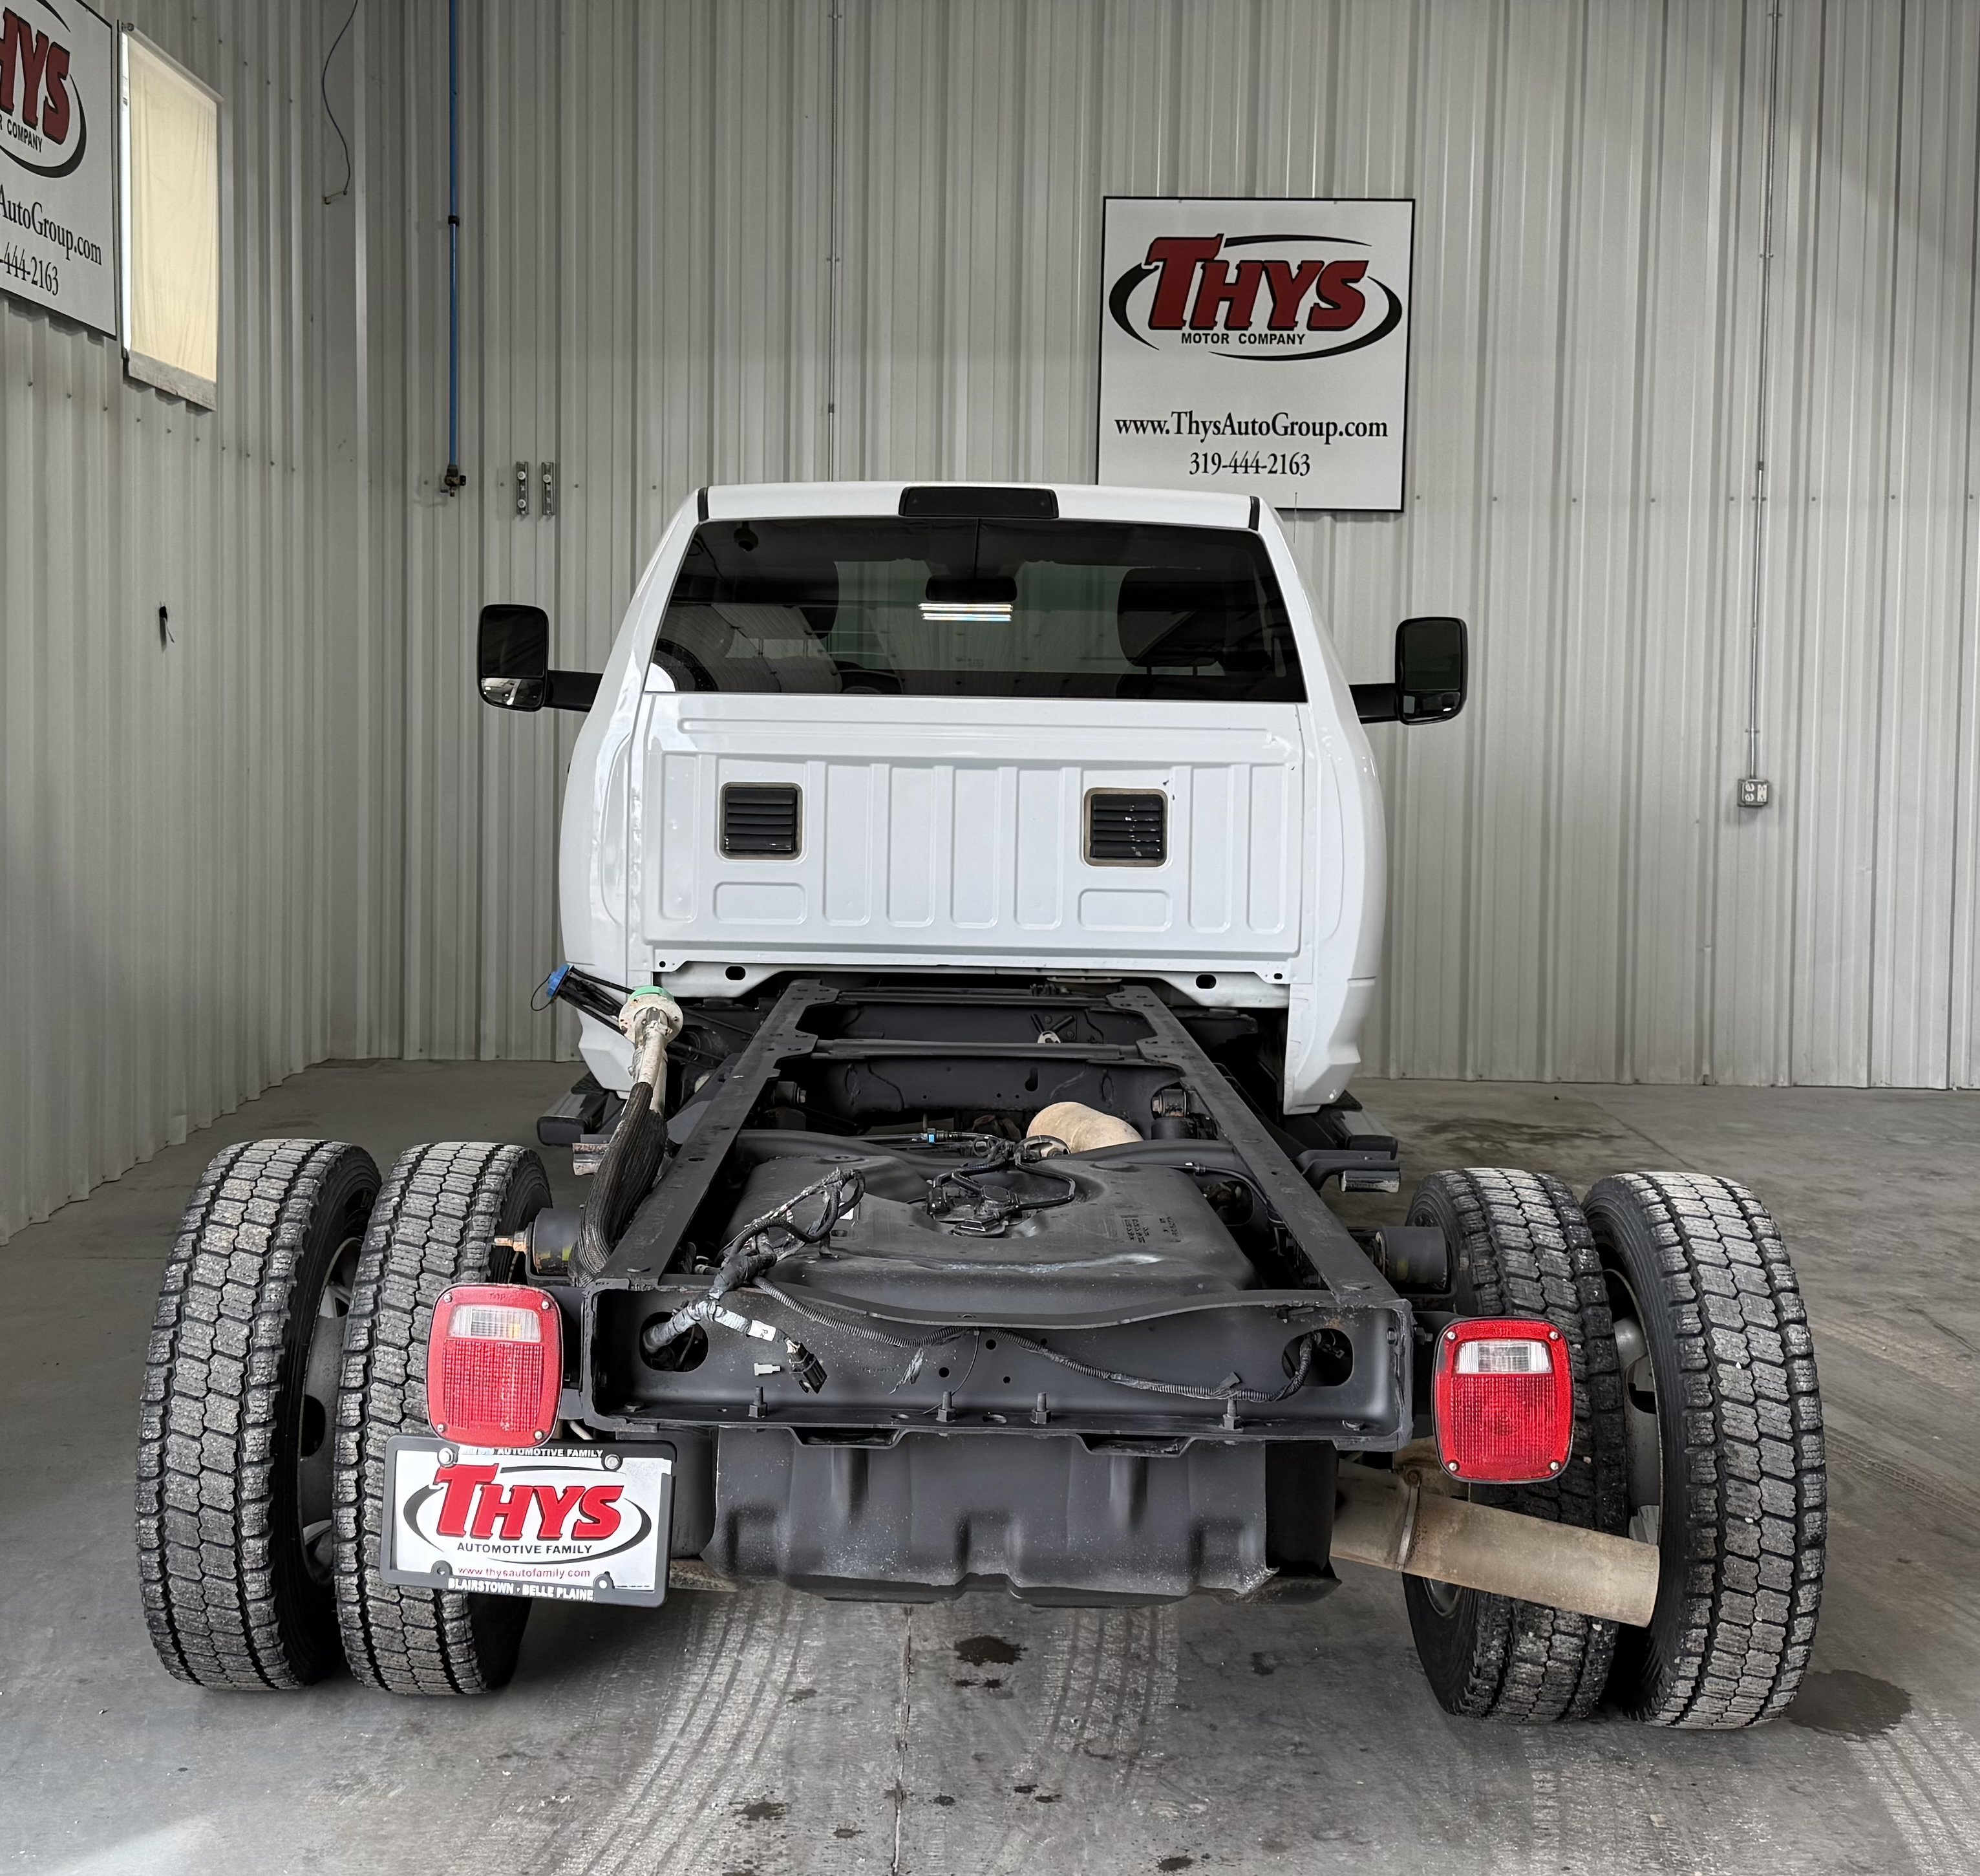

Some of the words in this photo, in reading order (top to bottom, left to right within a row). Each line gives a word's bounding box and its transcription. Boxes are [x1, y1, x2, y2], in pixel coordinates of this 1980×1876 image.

[6, 119, 43, 153] COMPANY
[1145, 233, 1370, 332] THYS
[1180, 332, 1230, 345] MOTOR
[1238, 332, 1306, 345] COMPANY
[1114, 410, 1389, 445] www.ThysAutoGroup.com
[1189, 451, 1311, 476] 319-444-2163
[496, 1448, 564, 1457] AUTOMOTIVE
[566, 1449, 604, 1458] FAMILY
[433, 1463, 625, 1541] THYS
[457, 1542, 542, 1554] AUTOMOTIVE
[546, 1545, 593, 1555] FAMILY
[447, 1577, 515, 1595] BLAIRSTOWN
[522, 1584, 555, 1599] BELLE
[556, 1586, 595, 1602] PLAINE
